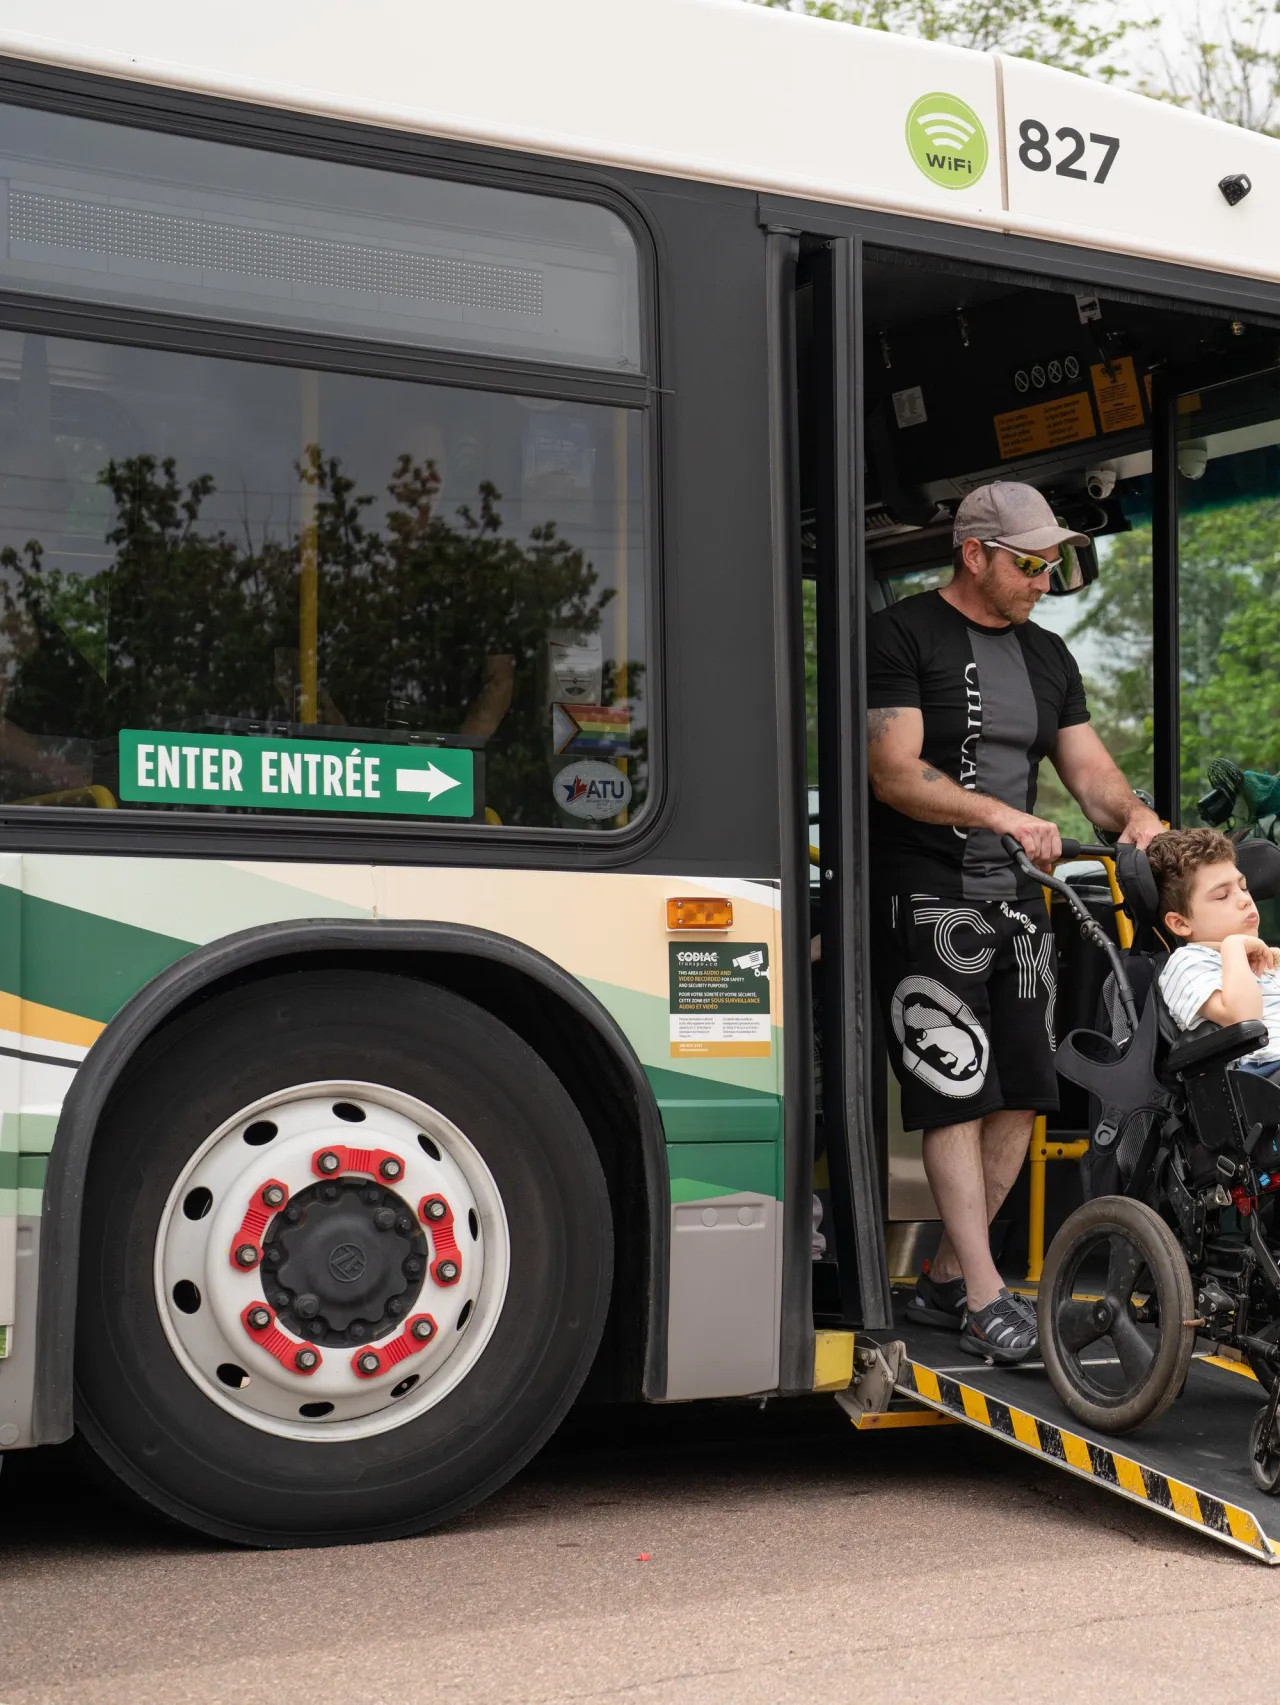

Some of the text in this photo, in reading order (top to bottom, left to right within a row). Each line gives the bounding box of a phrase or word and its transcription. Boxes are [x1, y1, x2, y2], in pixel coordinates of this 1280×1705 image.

[925, 152, 972, 174] WiFi
[1018, 118, 1120, 184] 827
[953, 662, 982, 840] CHICA
[137, 743, 381, 798] ENTER ENTRÉE
[586, 779, 625, 799] ATU
[1000, 900, 1037, 934] FAMOUS
[677, 951, 718, 962] CODIAC
